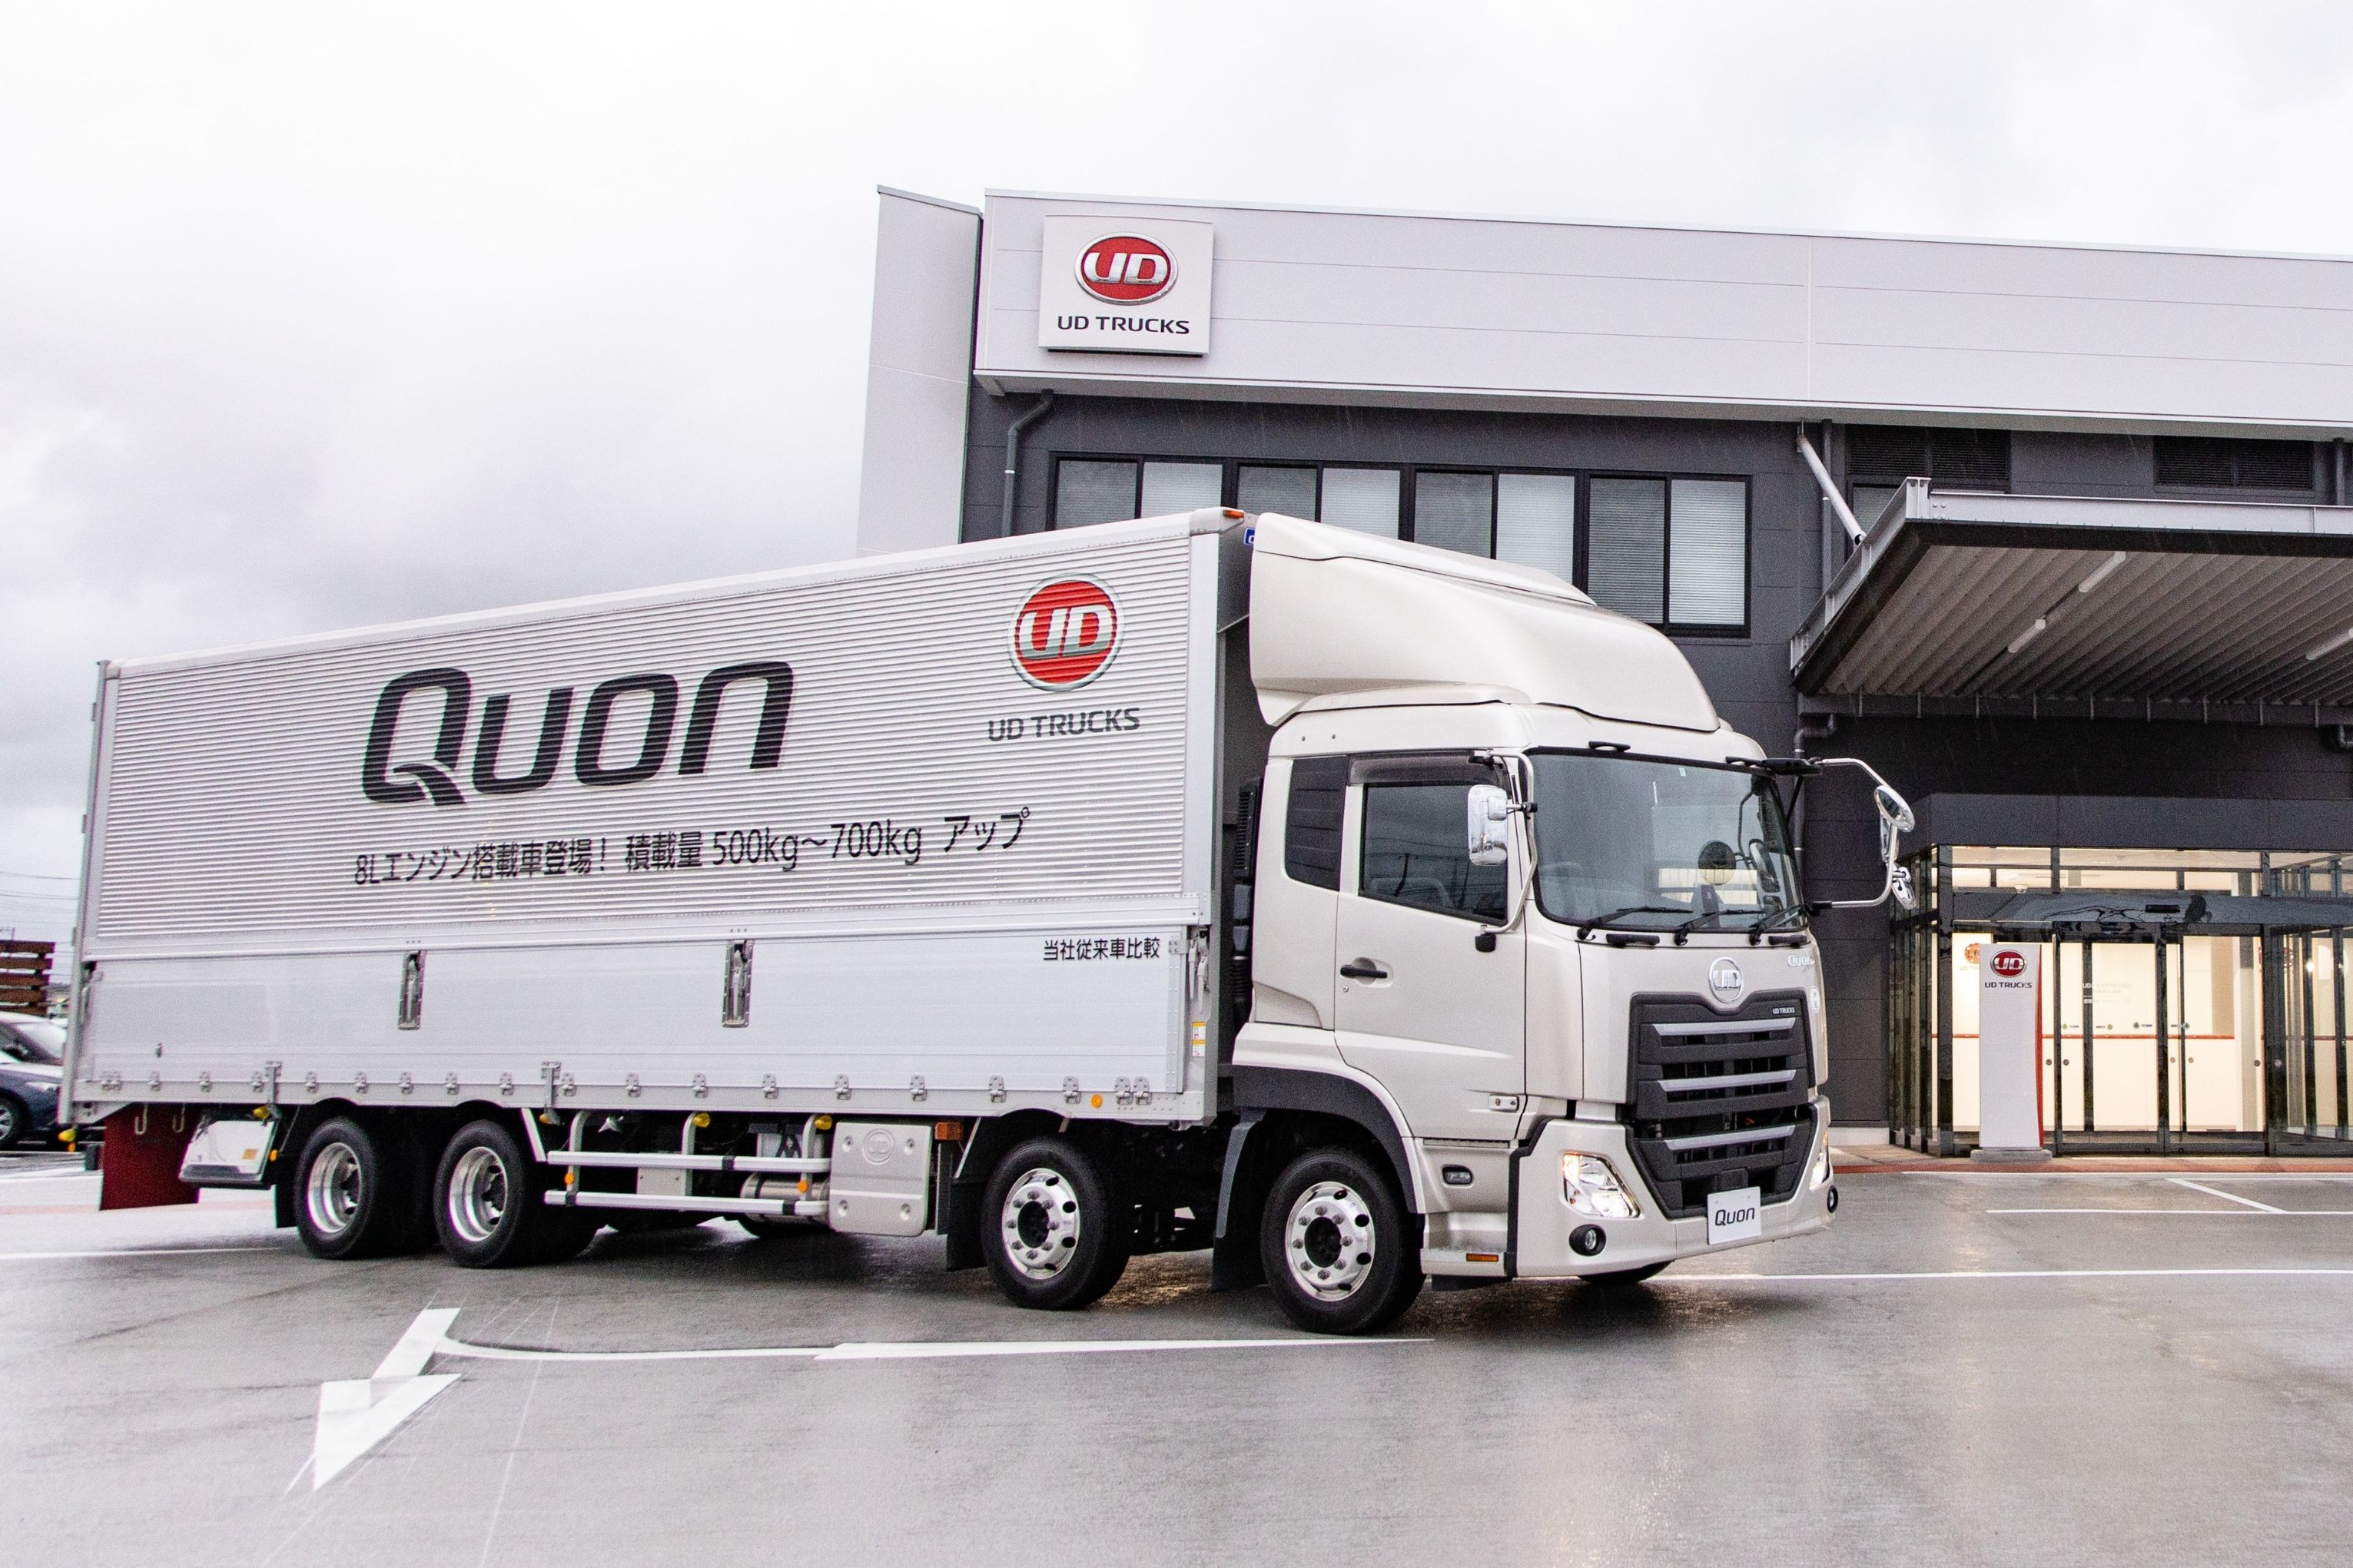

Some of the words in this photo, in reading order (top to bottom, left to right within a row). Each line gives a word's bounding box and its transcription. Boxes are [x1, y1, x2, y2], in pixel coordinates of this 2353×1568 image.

[1084, 252, 1168, 285] UD
[1057, 316, 1090, 330] UD
[1096, 317, 1190, 335] TRUCKS
[1019, 604, 1113, 661] UD
[988, 718, 1024, 741] UD
[1030, 707, 1140, 738] TRUCKS
[944, 806, 1030, 853] アップ
[1044, 936, 1160, 961] 当社従来車比較
[1993, 957, 2025, 970] UD
[1712, 970, 1742, 990] UD
